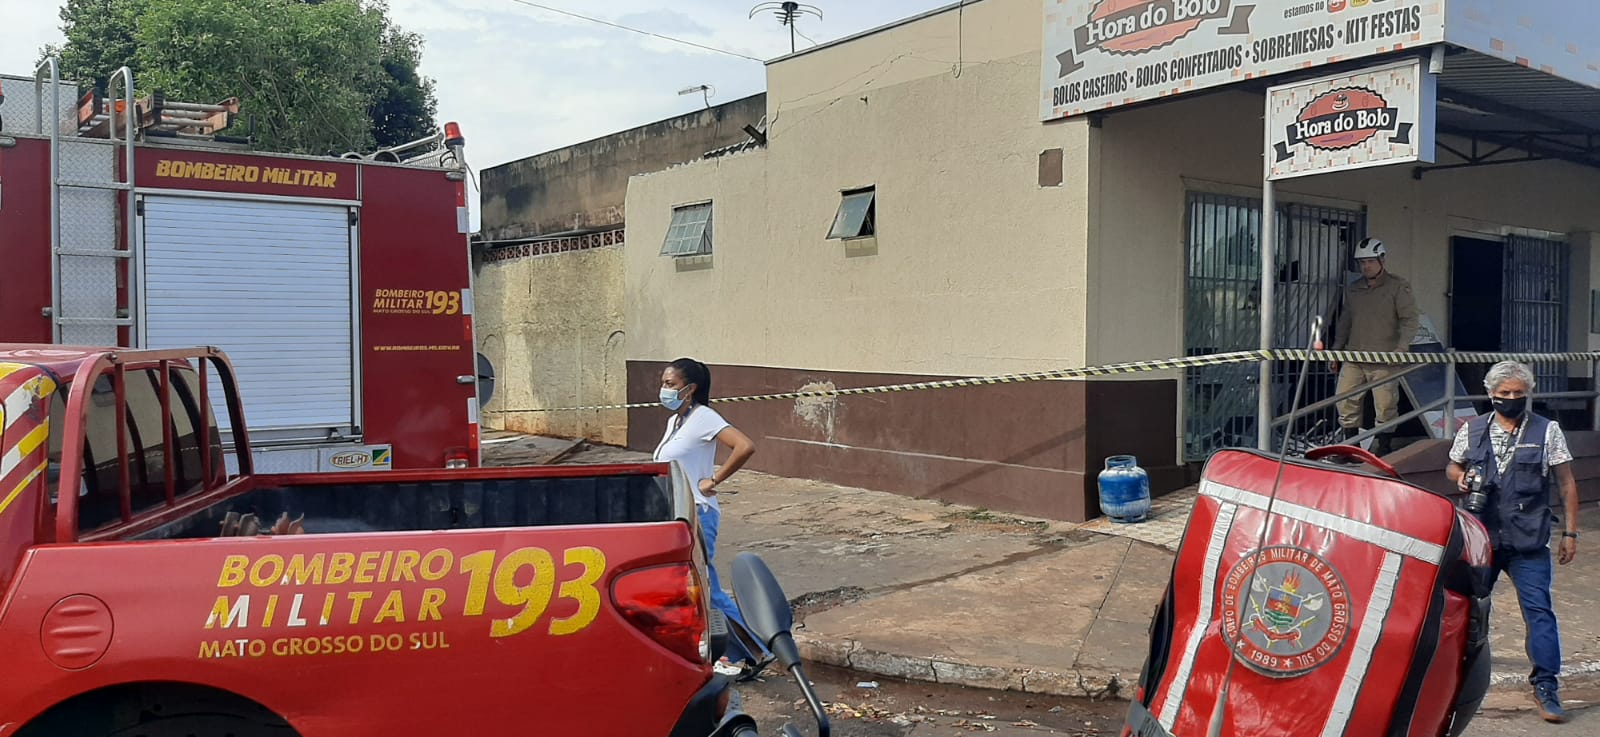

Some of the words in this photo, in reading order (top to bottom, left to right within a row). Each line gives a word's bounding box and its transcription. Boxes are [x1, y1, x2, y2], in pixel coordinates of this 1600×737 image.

[1086, 17, 1136, 45] Hora
[1140, 4, 1168, 29] do
[1172, 0, 1220, 21] Bolo
[1284, 3, 1314, 18] estamos
[1315, 2, 1324, 11] no
[1053, 80, 1080, 106] BOLOS
[1083, 71, 1127, 97] CASEIROS
[1136, 61, 1168, 88] BOLOS
[1170, 45, 1242, 79] CONFEITADOS
[1252, 24, 1334, 63] SOBREMESAS
[1346, 16, 1369, 45] KIT
[1371, 5, 1421, 39] FESTAS
[1296, 120, 1331, 139] Hora
[1334, 113, 1353, 132] do
[1356, 108, 1390, 128] Bolo
[156, 159, 259, 182] BOMBEIRO
[262, 166, 337, 188] MILITAR
[373, 298, 423, 309] MILITAR
[375, 289, 425, 298] BOMBEIRO
[425, 290, 460, 315] 193
[1270, 548, 1308, 563] MILITAR
[1310, 559, 1324, 571] DE
[217, 548, 454, 588] BOMBEIRO
[460, 546, 606, 637] 193
[1321, 571, 1342, 598] MATO
[203, 588, 447, 629] MILITAR
[1225, 594, 1234, 606] DE
[1327, 603, 1345, 641] GROSSO
[198, 638, 266, 658] MATO
[272, 635, 363, 656] GROSSO
[370, 633, 403, 651] DO
[409, 631, 450, 650] SUL
[1316, 642, 1330, 656] DO
[1250, 650, 1278, 667] 1989
[1298, 655, 1315, 666] SUL
